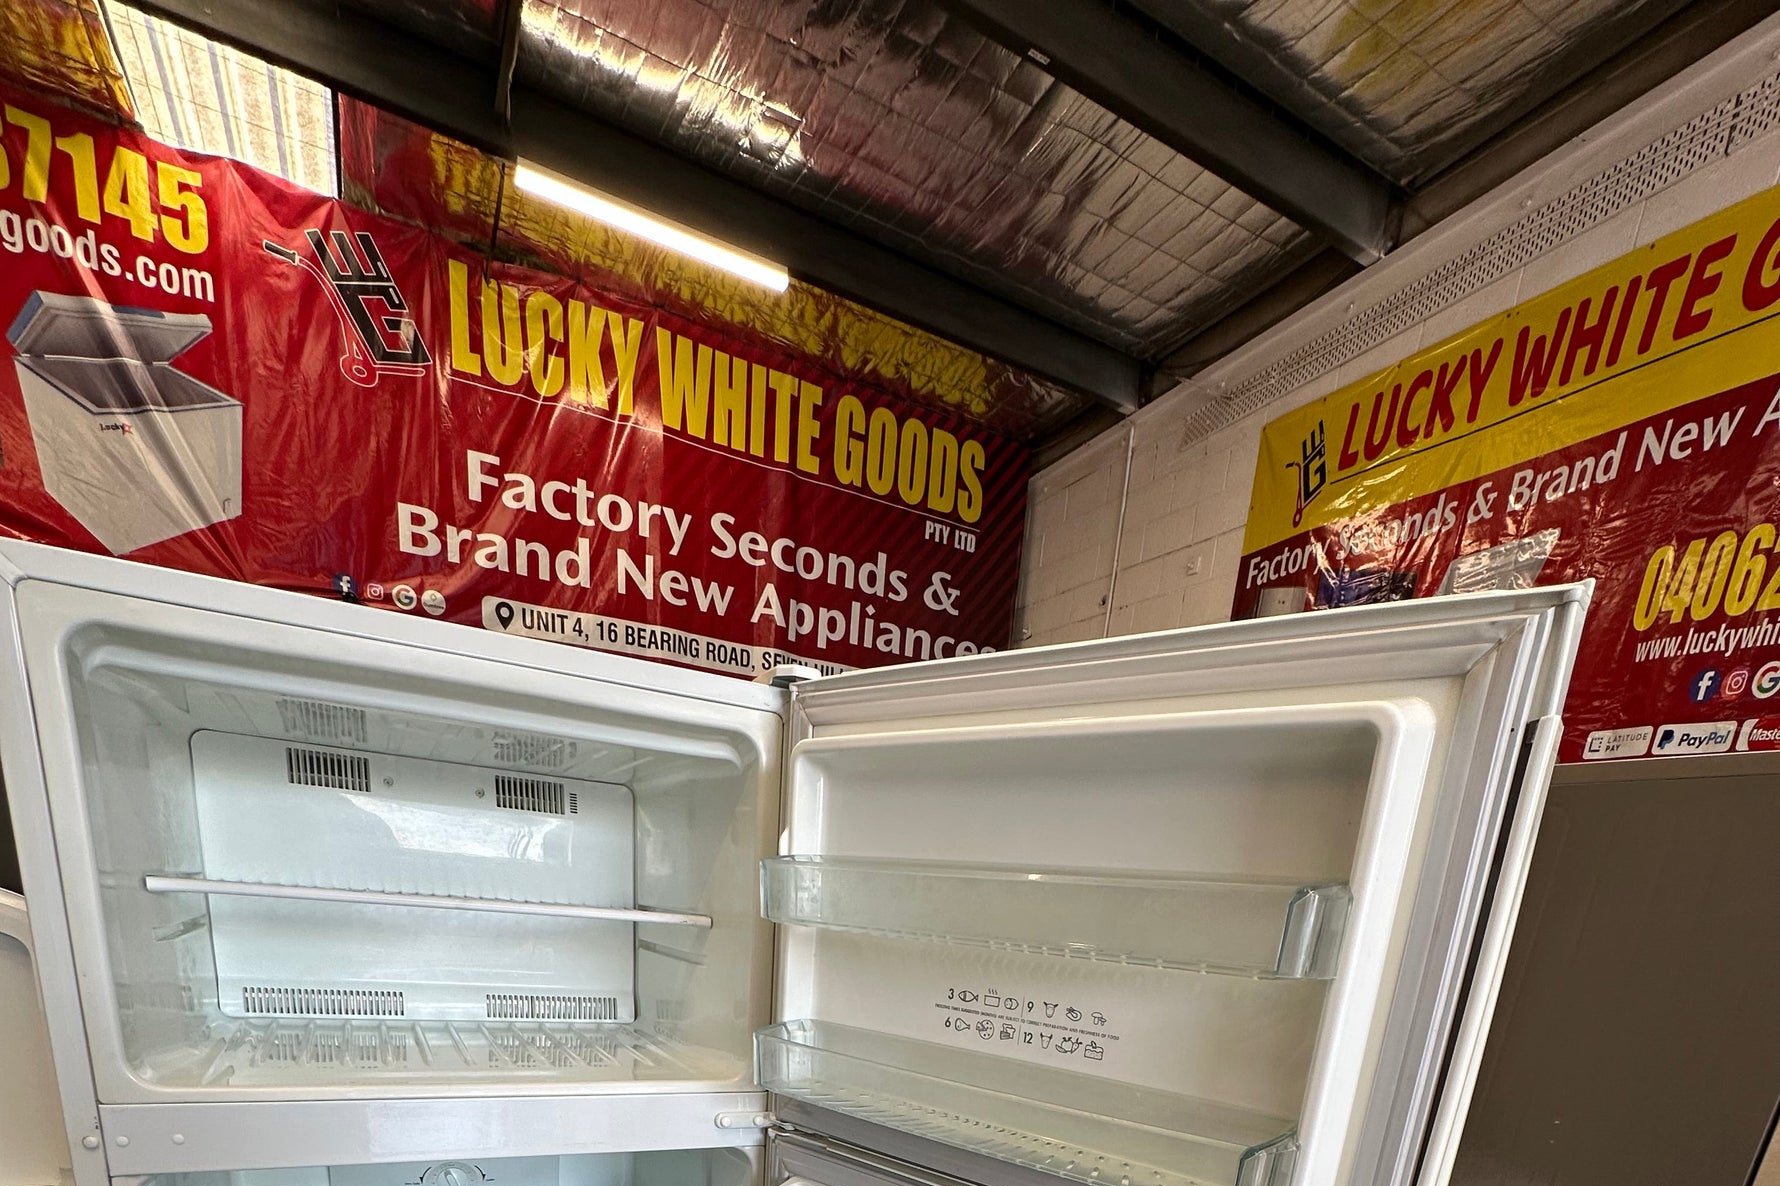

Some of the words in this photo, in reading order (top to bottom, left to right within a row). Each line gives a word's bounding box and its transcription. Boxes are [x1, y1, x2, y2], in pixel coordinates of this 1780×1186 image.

[1338, 338, 1503, 471] LUCKY
[1508, 232, 1738, 407] WHITE
[448, 258, 645, 417] LUCKY
[656, 326, 823, 475] WHITE
[833, 394, 986, 523] GOODS
[1246, 537, 1331, 590] Factory
[1467, 481, 1498, 524] &
[1507, 430, 1629, 512] Brand
[1634, 405, 1747, 473] New
[466, 449, 692, 555] Factory
[710, 512, 909, 602] Seconds
[924, 571, 961, 616] &
[924, 520, 951, 548] PTY
[954, 526, 977, 553] LTD
[397, 502, 592, 590] Brand
[617, 546, 735, 617] New
[750, 582, 997, 661] Appliance
[522, 608, 569, 635] UNIT
[572, 617, 589, 642] 4,
[596, 620, 619, 643] 16
[625, 625, 701, 659] BEARING
[706, 641, 757, 672] ROAD,
[1605, 744, 1622, 753] PAY
[1607, 732, 1649, 744] LATITUDE
[1678, 730, 1731, 748] PayPal
[948, 988, 955, 1000] 3
[1027, 1001, 1034, 1013] 9
[944, 1016, 951, 1028] 6
[1023, 1032, 1033, 1045] 12
